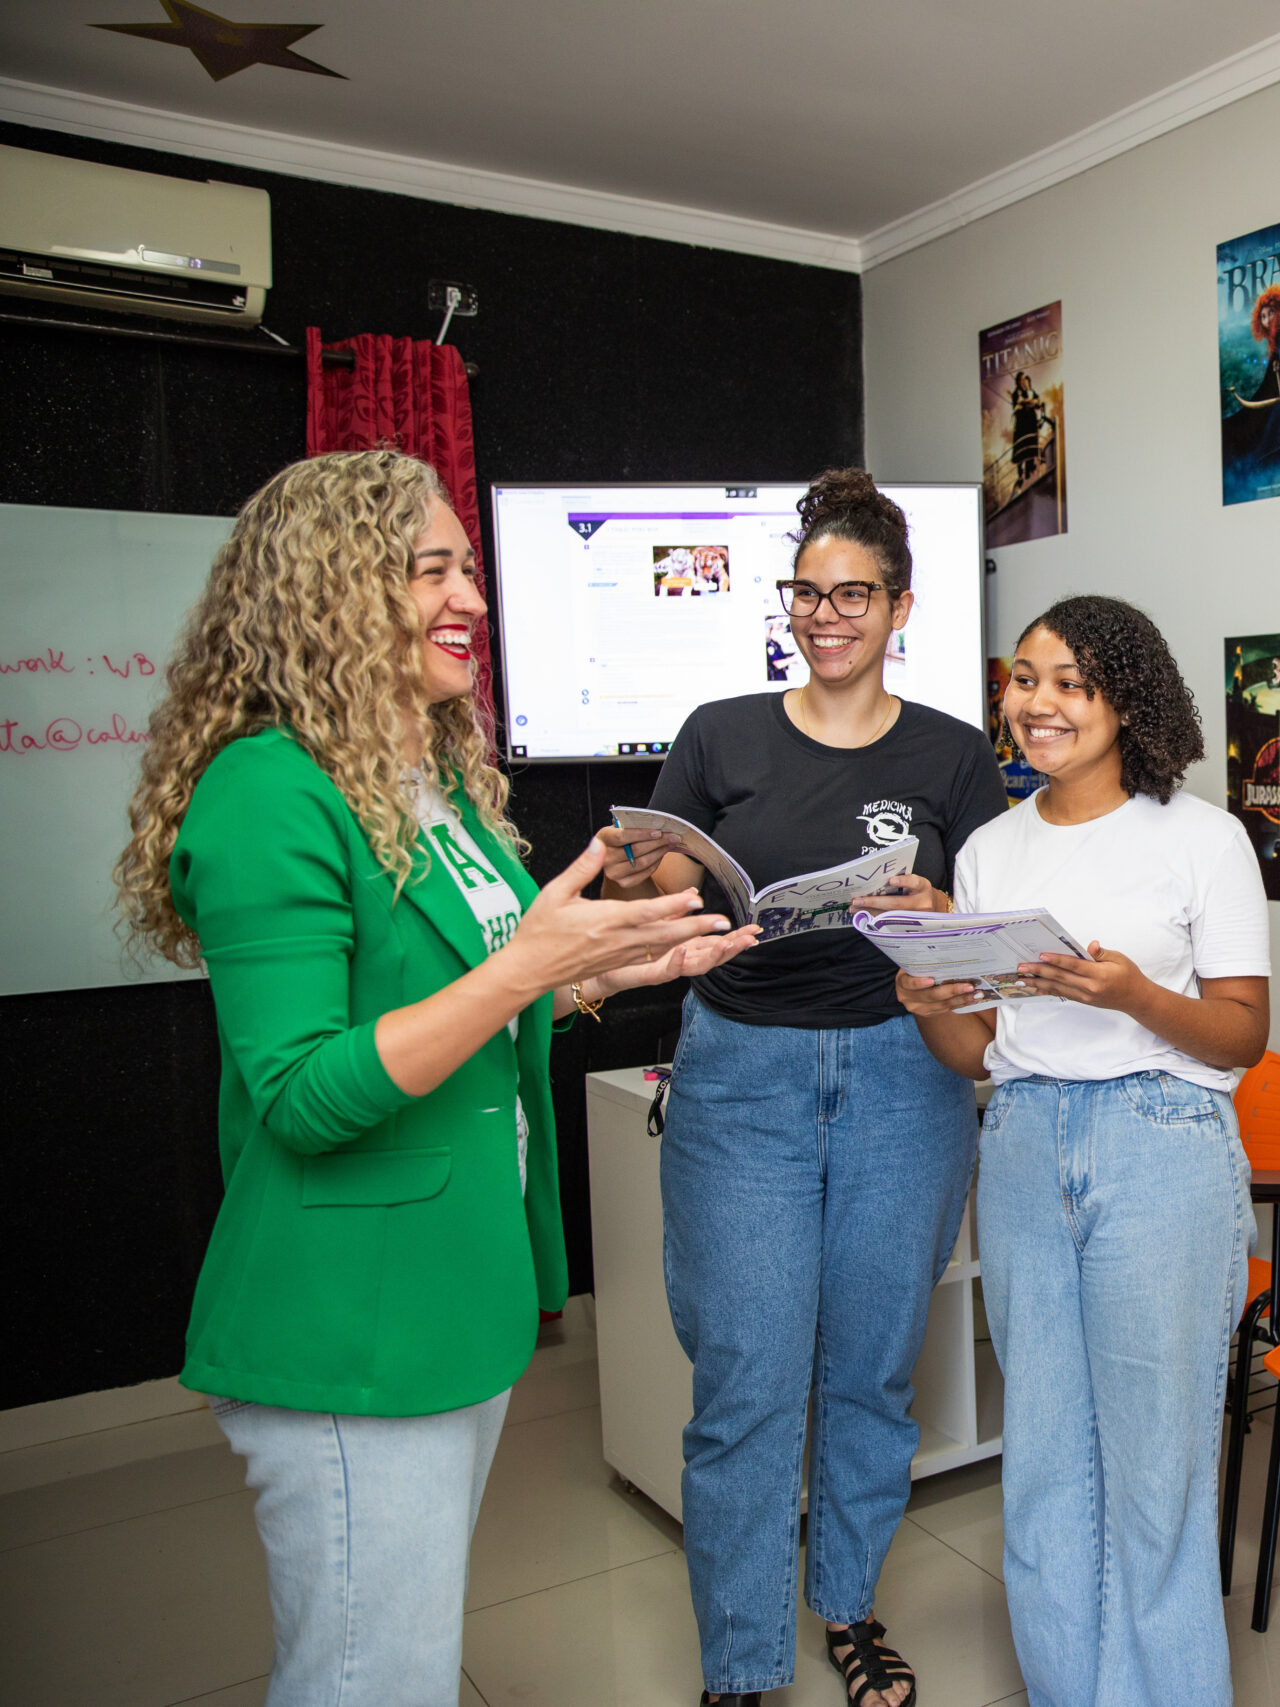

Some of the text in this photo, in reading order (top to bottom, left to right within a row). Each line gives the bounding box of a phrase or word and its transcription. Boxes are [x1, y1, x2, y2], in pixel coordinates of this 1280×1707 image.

[982, 331, 1059, 378] TITANIC
[578, 522, 592, 533] 3.1
[862, 799, 913, 821] MEDICINA
[771, 859, 897, 903] EVOLVE
